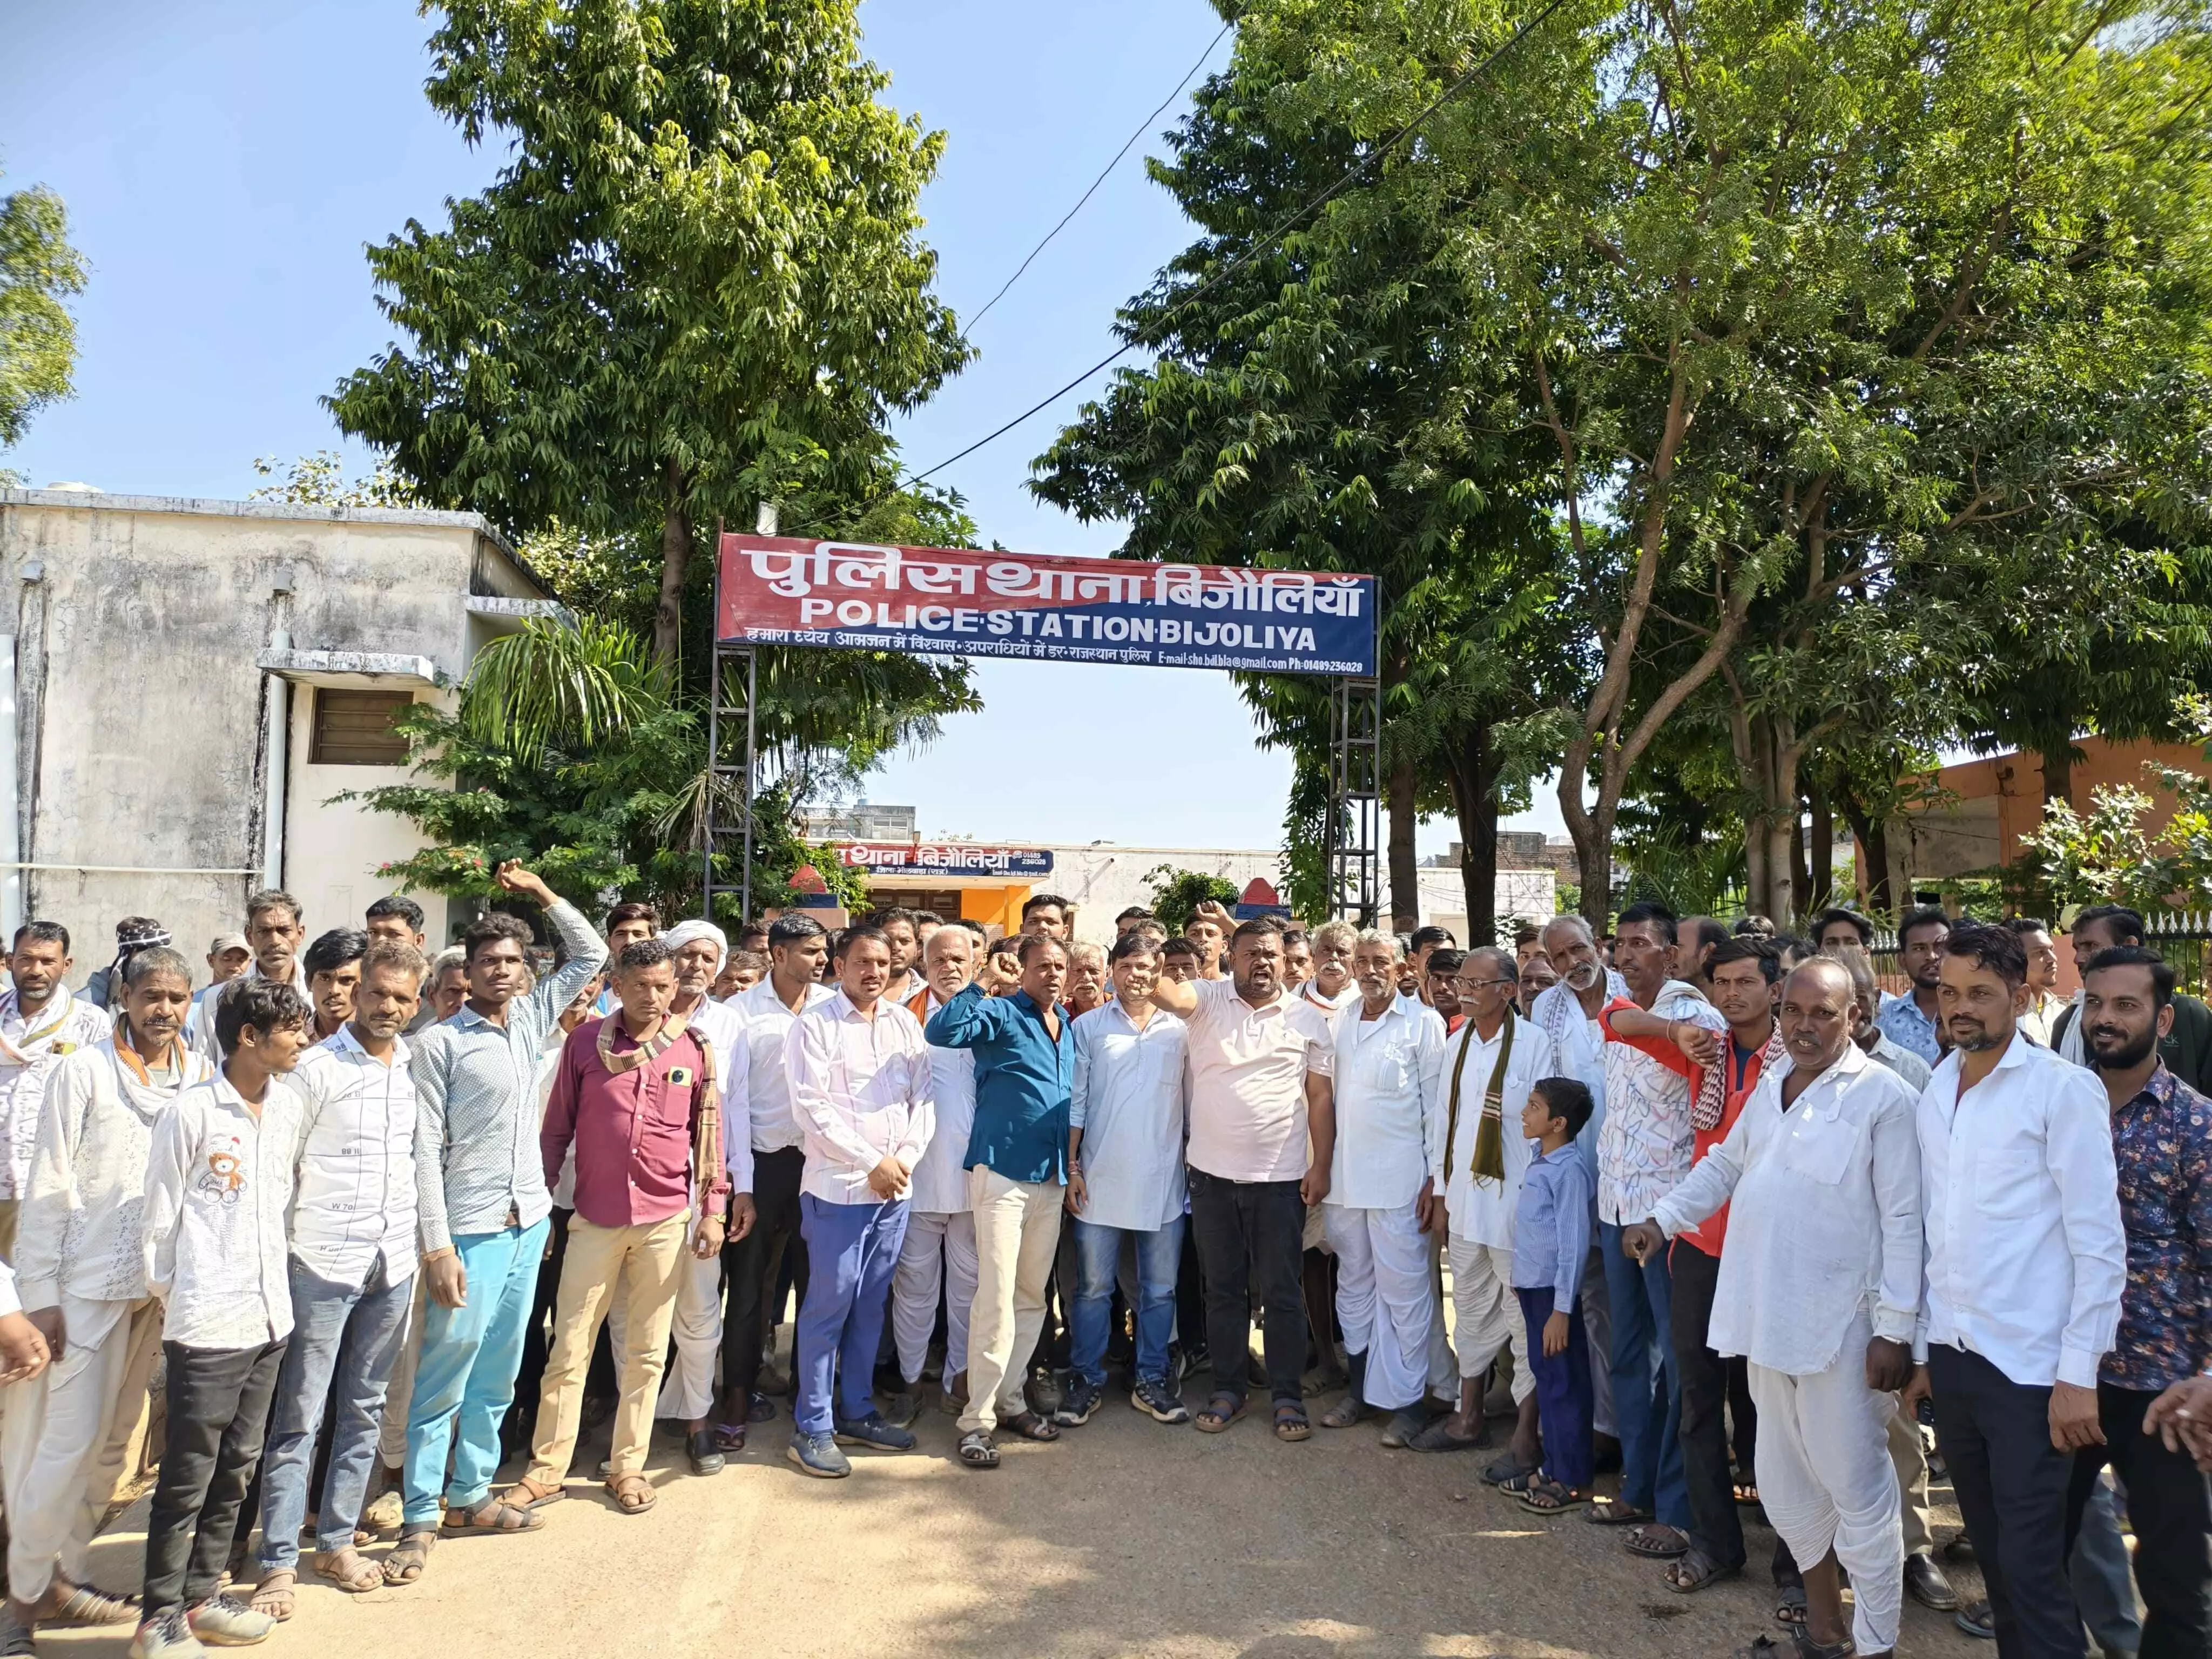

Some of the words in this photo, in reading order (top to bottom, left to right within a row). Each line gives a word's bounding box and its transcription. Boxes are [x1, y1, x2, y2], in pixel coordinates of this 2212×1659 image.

[740, 541, 982, 597] पुलिस
[744, 627, 790, 642] हमारा
[834, 631, 891, 648] आमजन
[893, 632, 907, 649] में
[962, 638, 1031, 656] अपराधियों
[1032, 639, 1047, 657] में
[1069, 646, 1119, 660] राजस्थान
[1120, 646, 1152, 663] पुलिस
[1159, 619, 1316, 651] BIJOLIYA
[849, 845, 909, 865] थाना
